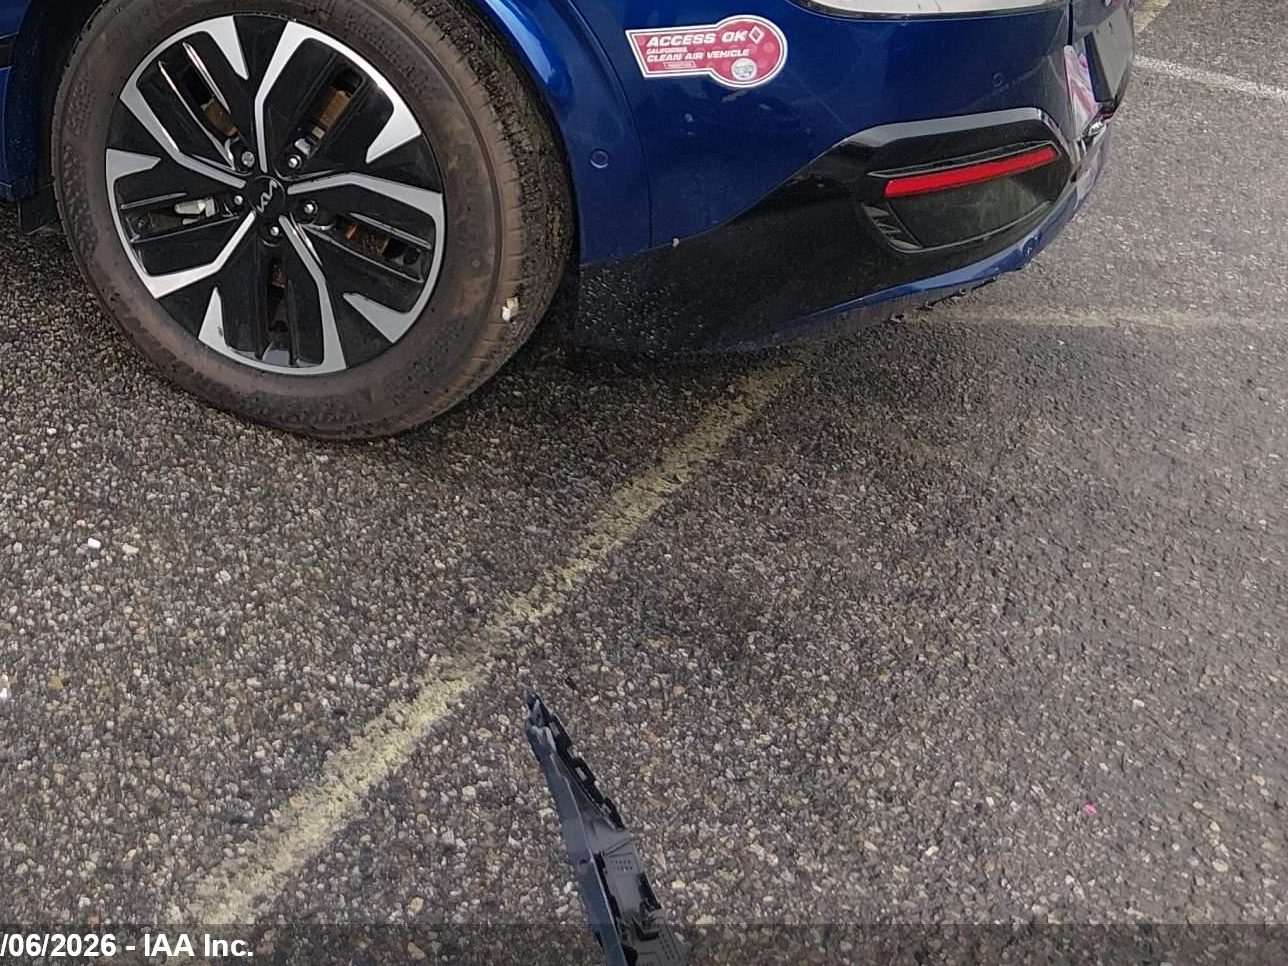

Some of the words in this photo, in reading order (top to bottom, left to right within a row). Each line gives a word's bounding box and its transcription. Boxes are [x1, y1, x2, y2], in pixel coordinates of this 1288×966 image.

[646, 33, 716, 47] ACCESS
[721, 30, 748, 43] OK
[646, 47, 688, 55] CALIFORNIA
[647, 53, 682, 63] CLEAN
[685, 52, 704, 61] AIR
[707, 48, 750, 59] VEHICLE
